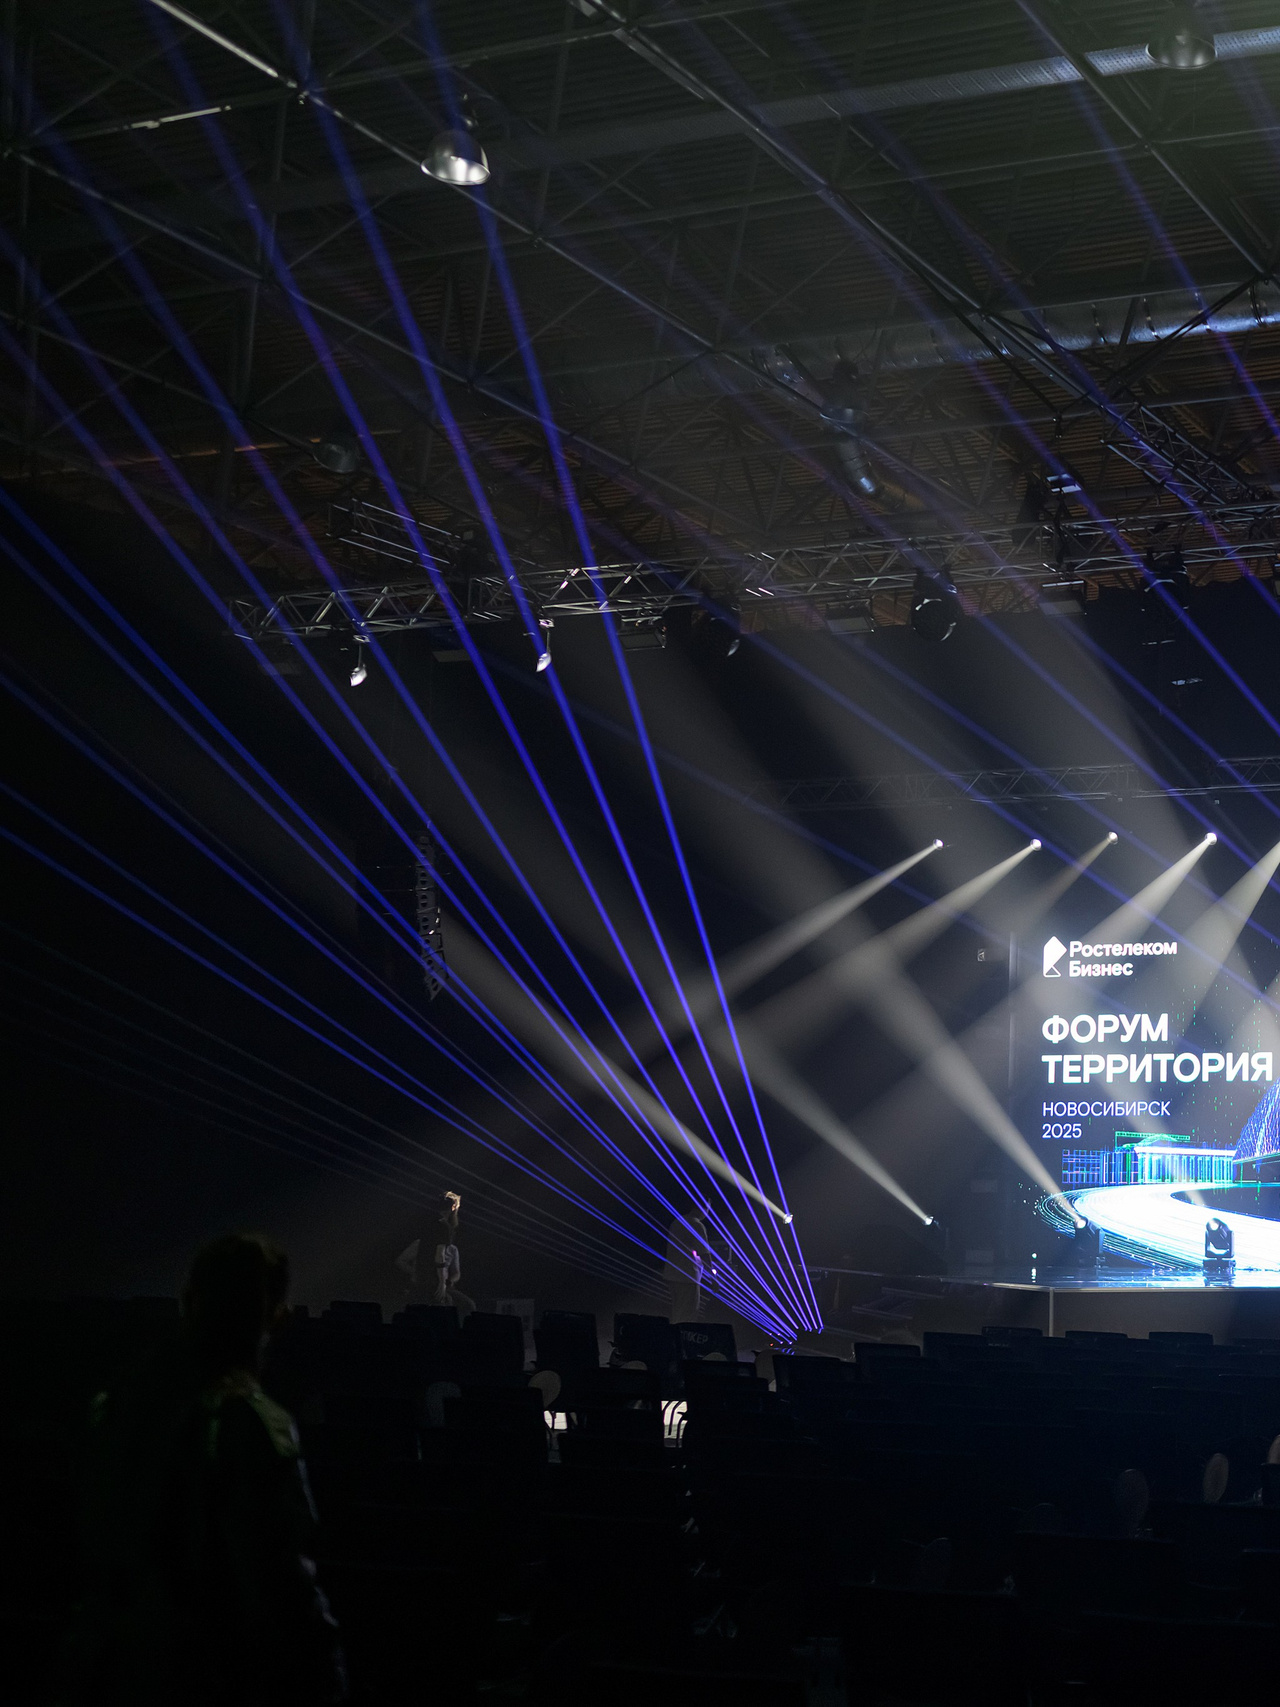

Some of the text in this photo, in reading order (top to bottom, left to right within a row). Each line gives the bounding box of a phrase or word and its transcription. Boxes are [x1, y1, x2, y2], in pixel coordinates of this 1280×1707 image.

[1069, 941, 1177, 957] Ростелеком
[1069, 960, 1134, 977] Бизнес
[1042, 1013, 1169, 1043] ФОРУМ
[1041, 1052, 1273, 1083] ТЕРРИТОРИЯ
[1042, 1101, 1171, 1117] НОВОСИБИРСК
[1042, 1123, 1082, 1139] 2025
